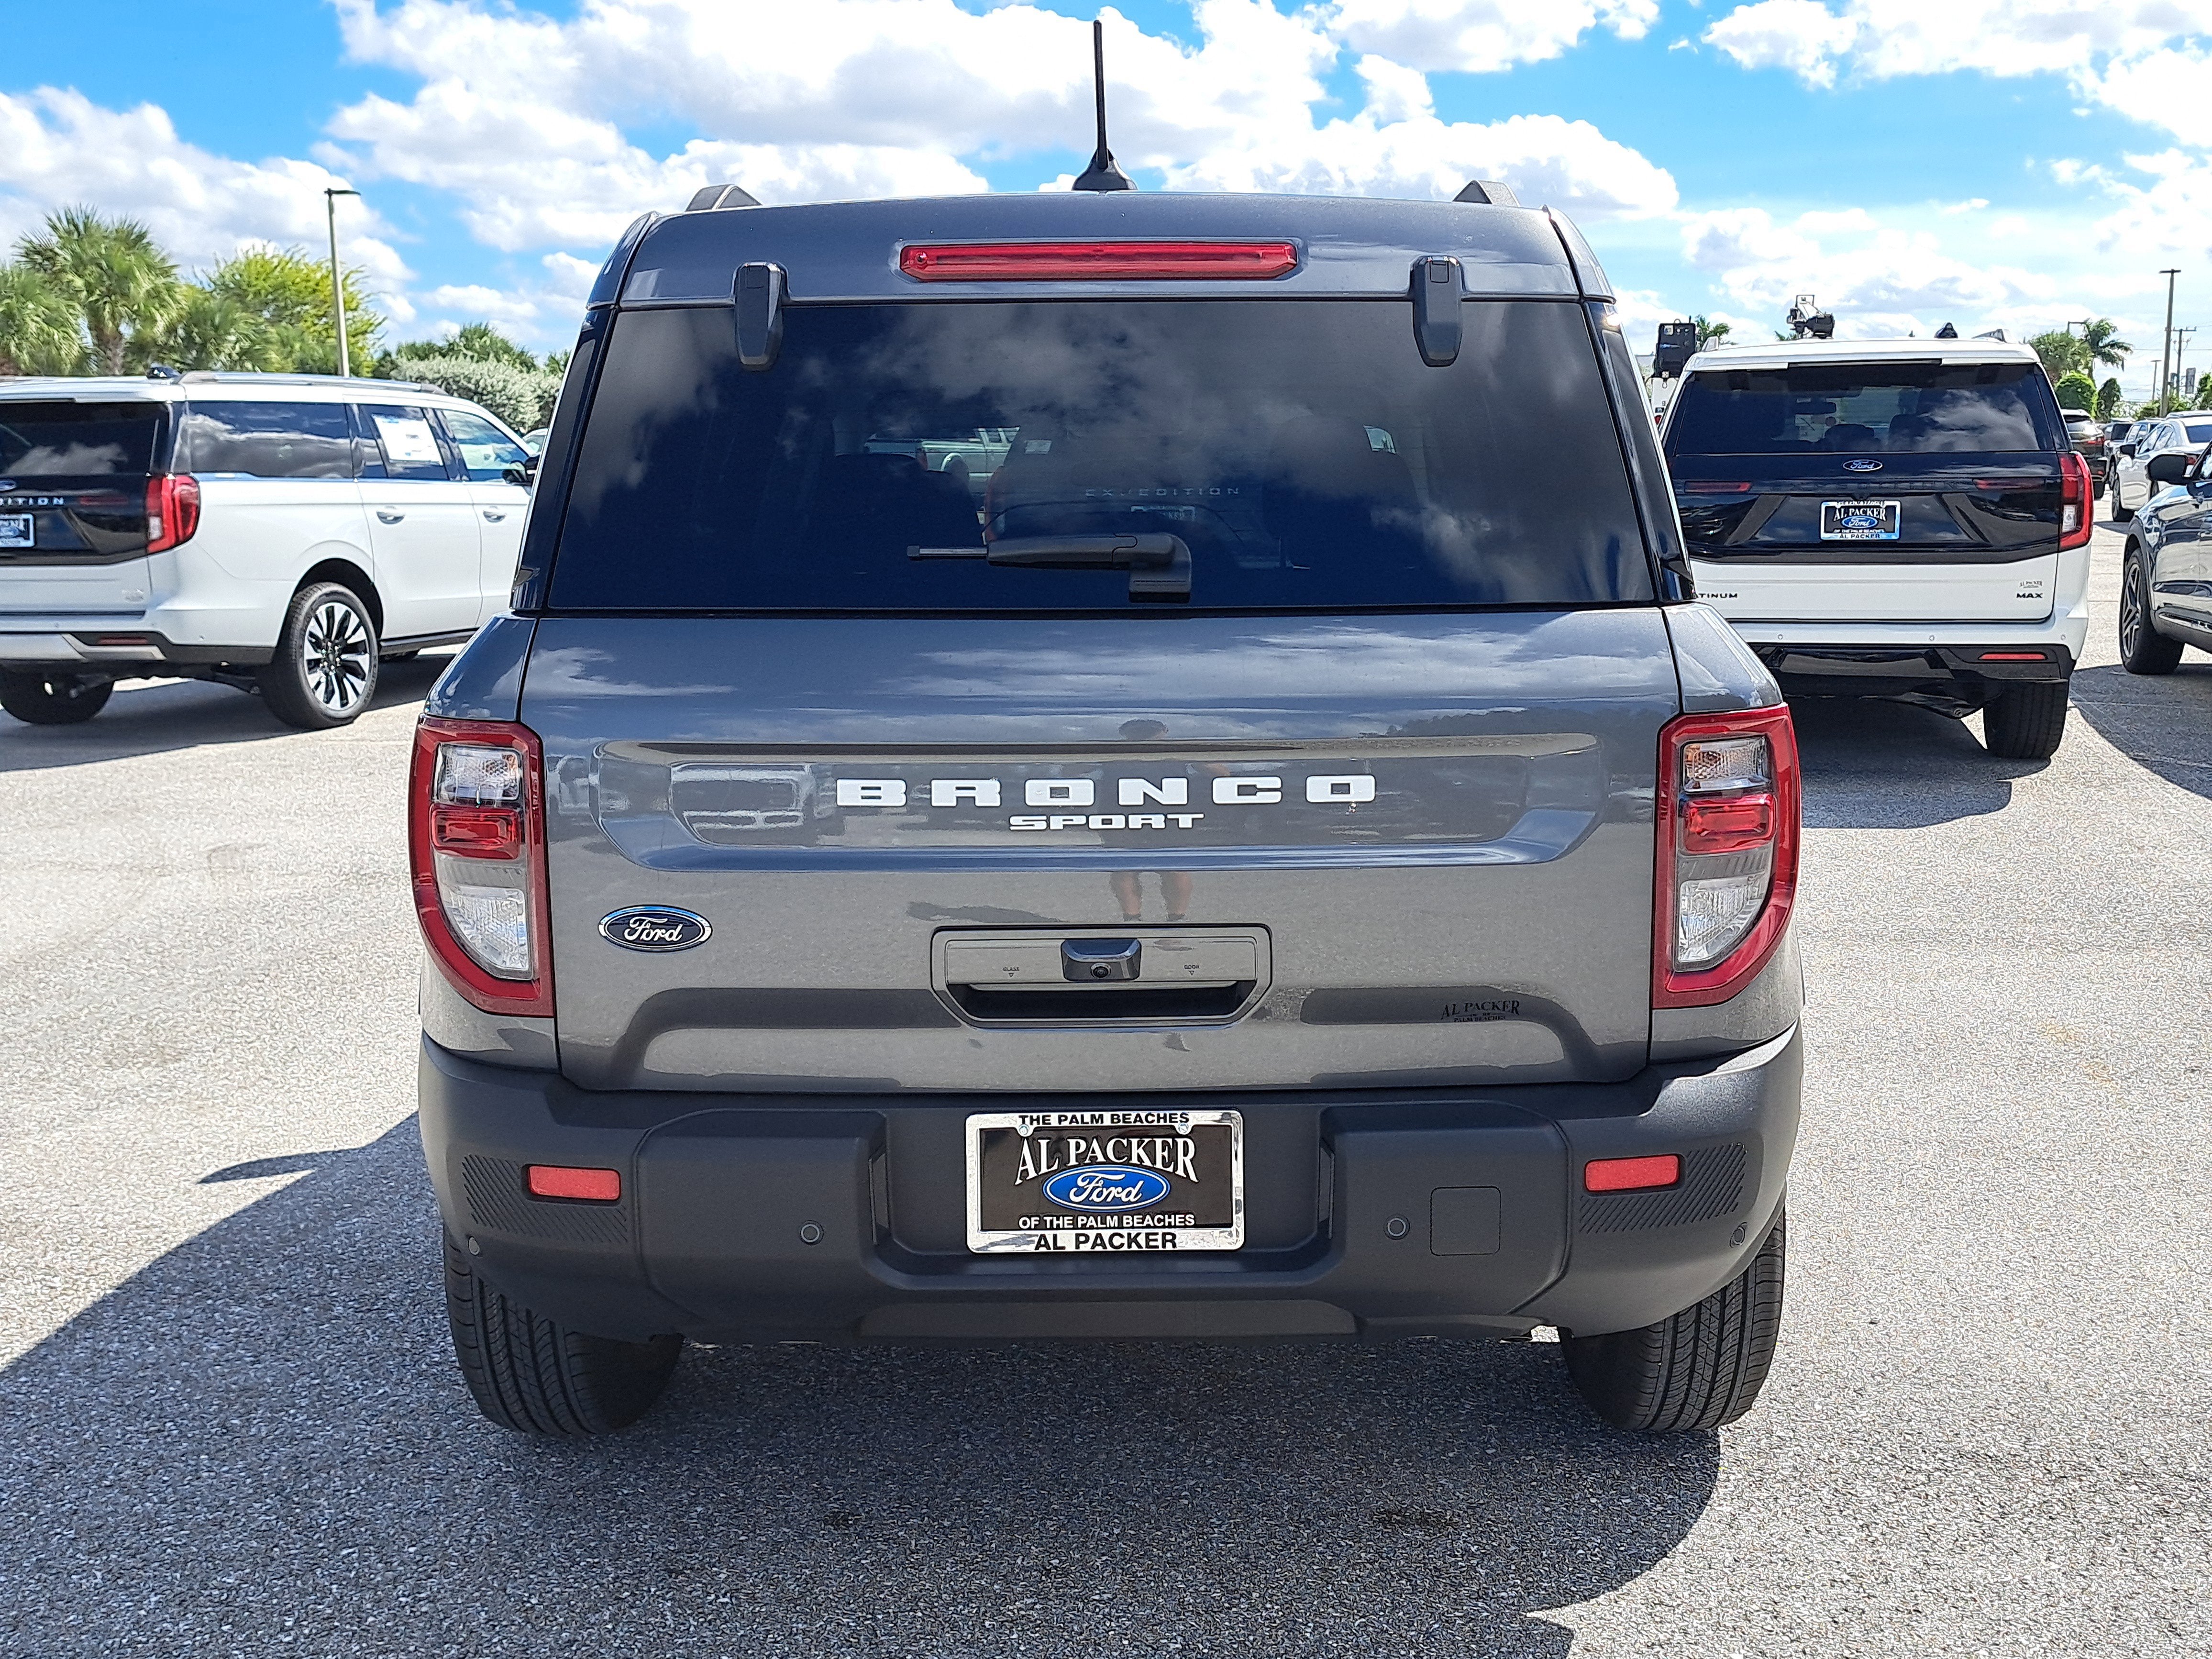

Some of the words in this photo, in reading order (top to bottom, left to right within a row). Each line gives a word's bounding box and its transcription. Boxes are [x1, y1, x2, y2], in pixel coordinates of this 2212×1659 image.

[1833, 508, 1847, 521] AL
[1849, 507, 1886, 521] PACKER
[836, 774, 1376, 807] BRONCO
[1009, 813, 1205, 831] SPORT
[624, 916, 684, 942] Ford
[1441, 1004, 1460, 1020] AL
[1464, 999, 1520, 1016] PACKER
[1018, 1114, 1051, 1125] THE
[1058, 1114, 1104, 1125] PALM
[1110, 1112, 1189, 1124] BEACHES
[1014, 1138, 1059, 1185] AL
[1066, 1138, 1200, 1183] PACKER
[1069, 1172, 1144, 1203] Ford
[1018, 1217, 1040, 1229] OF
[1043, 1217, 1073, 1228] THE
[1077, 1216, 1118, 1228] PALM
[1123, 1214, 1195, 1227] BEACHES
[1034, 1233, 1066, 1250] AL
[1075, 1232, 1177, 1250] PACKER
